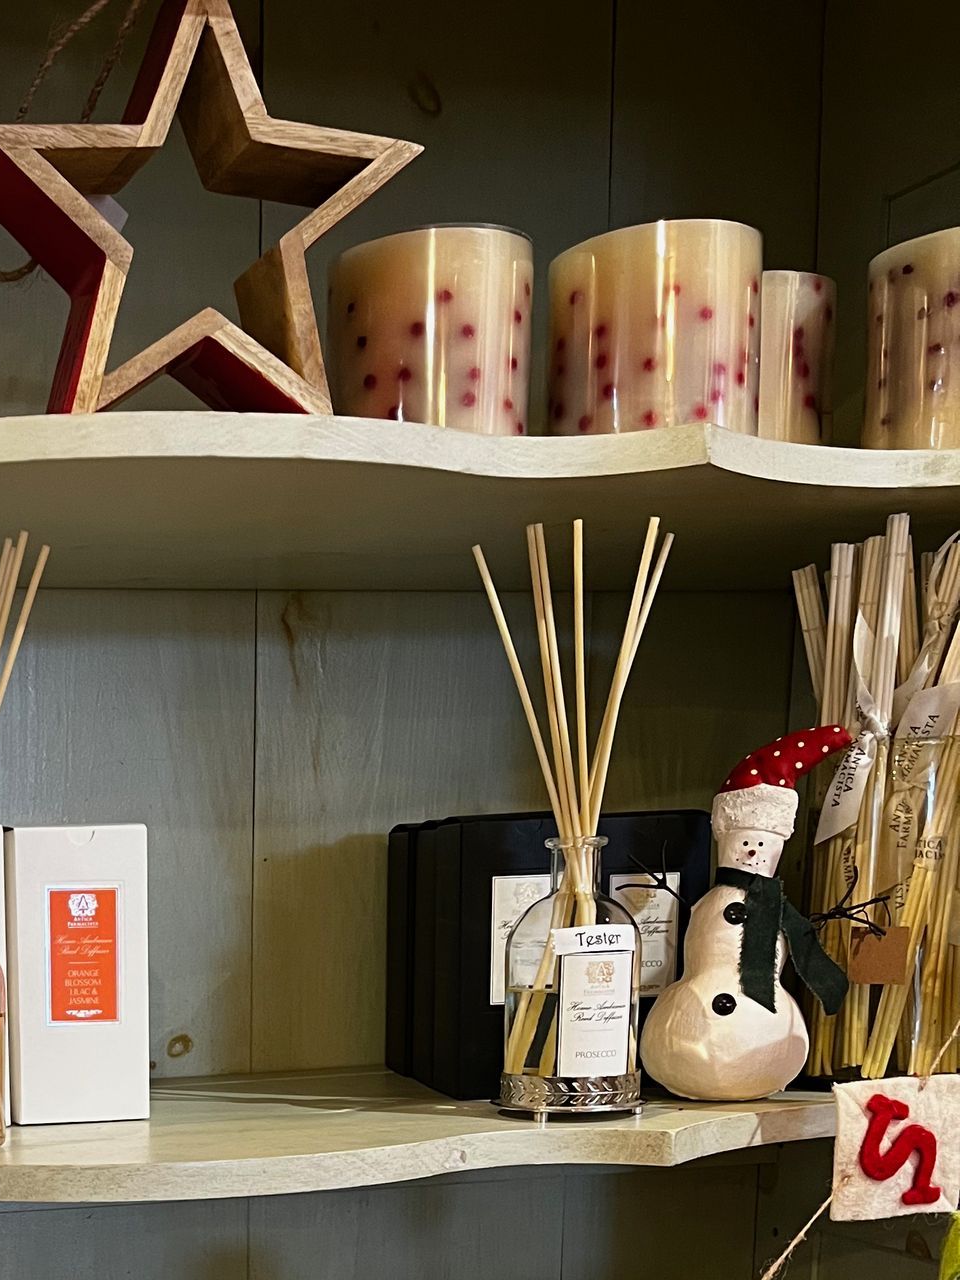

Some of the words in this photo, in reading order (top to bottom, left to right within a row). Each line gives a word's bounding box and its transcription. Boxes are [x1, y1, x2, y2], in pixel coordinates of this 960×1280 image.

[575, 932, 622, 948] Tester
[67, 969, 100, 978] ORANGE
[65, 978, 102, 987] BLOSSOM
[69, 988, 90, 996] LILAC
[69, 996, 100, 1005] JASMINE
[575, 1050, 617, 1059] PROSECCO
